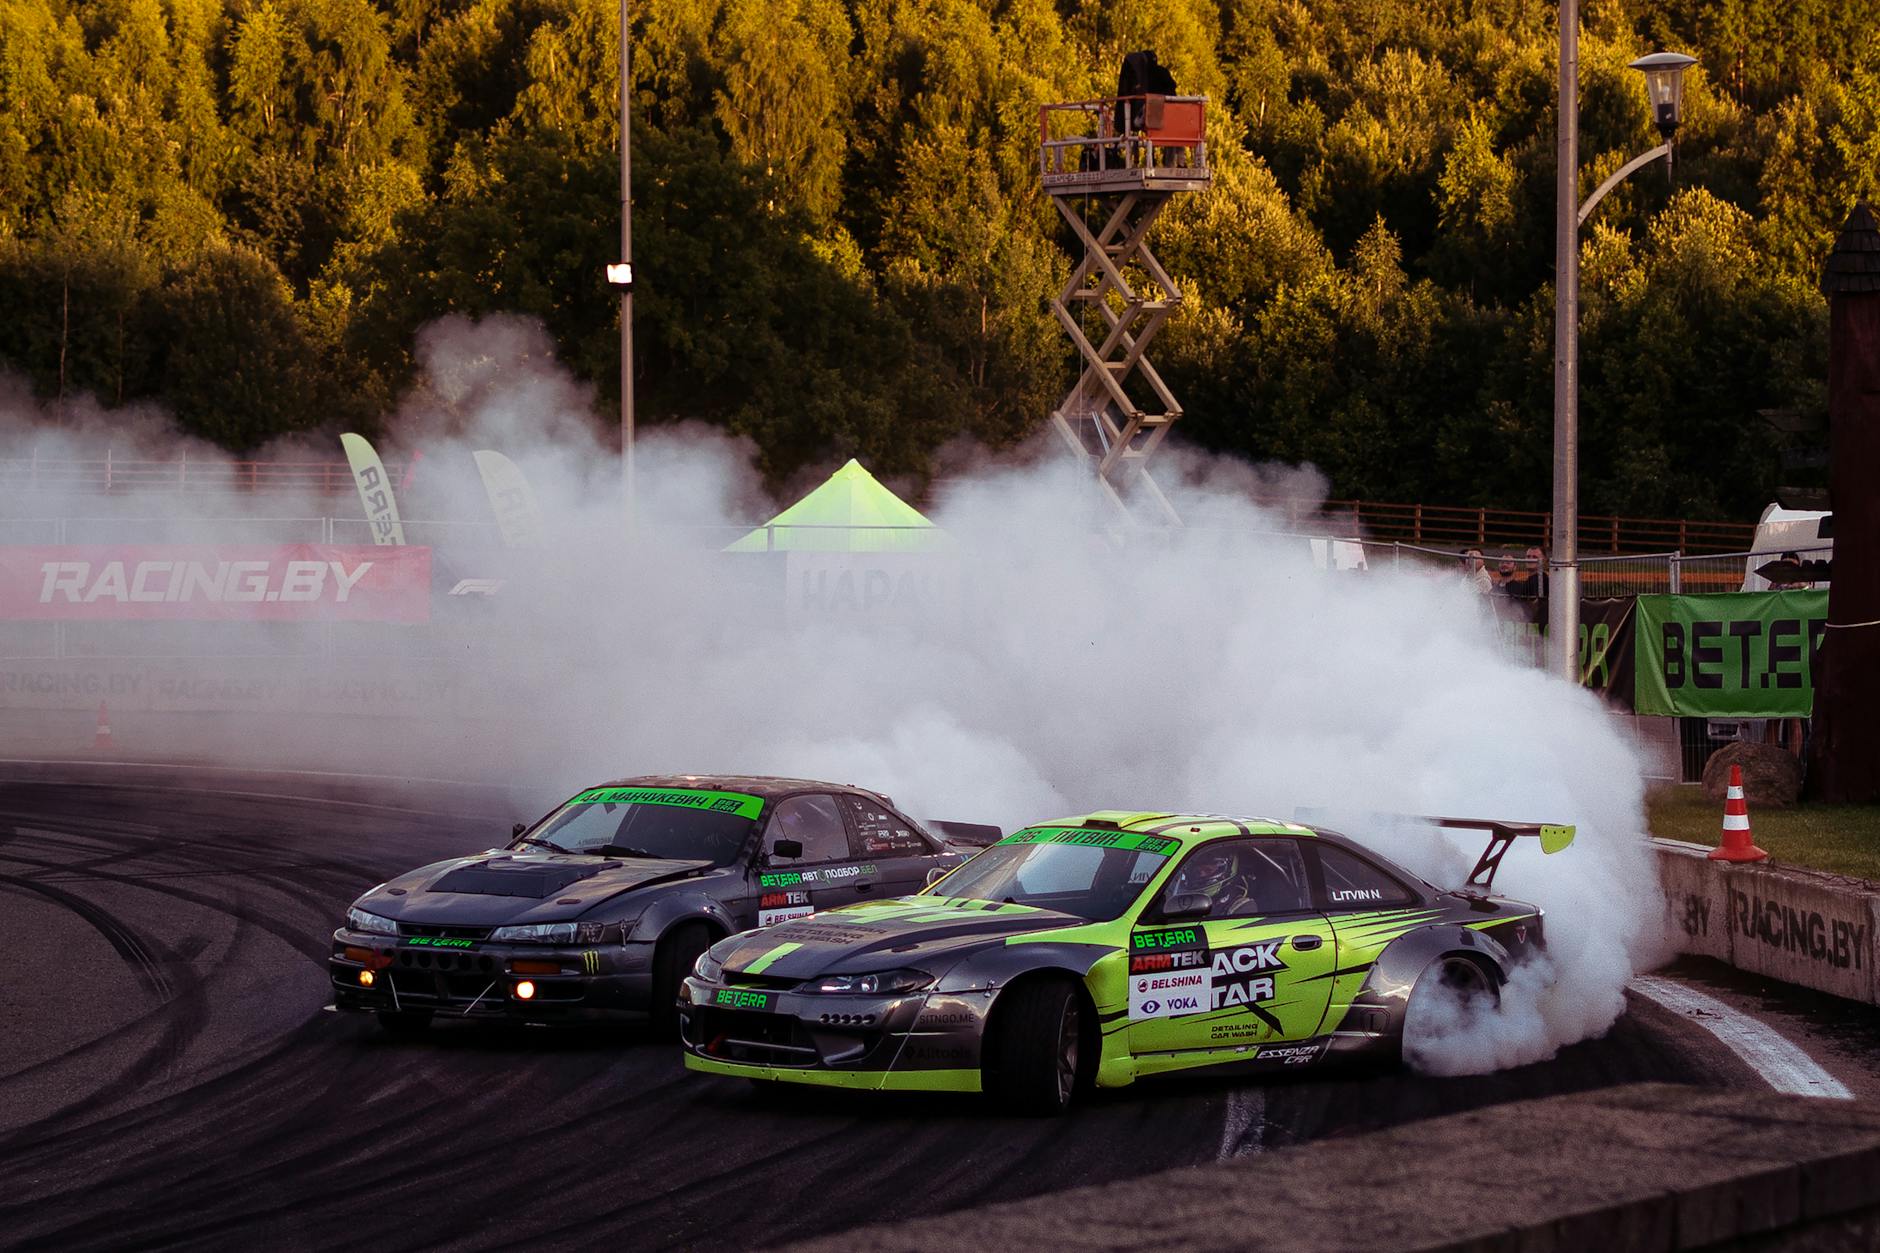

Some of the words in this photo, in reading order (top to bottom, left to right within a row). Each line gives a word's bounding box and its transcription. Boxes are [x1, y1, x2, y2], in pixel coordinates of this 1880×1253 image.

[607, 792, 709, 806] МАНЧУКЕВИЧ
[1050, 830, 1125, 846] ЛИТВИН
[761, 872, 802, 887] BETERA
[761, 891, 809, 907] ARMTEK
[1332, 889, 1369, 901] LITVIN
[1733, 888, 1866, 970] RACING.BY
[409, 936, 473, 948] BETERA
[1134, 930, 1197, 948] BETERA
[1132, 950, 1205, 971] ARMTEK
[1211, 942, 1281, 977] ACK
[1151, 975, 1203, 990] BELSHINA
[716, 989, 767, 1008] BETERA
[1211, 977, 1274, 1009] TAR
[1167, 997, 1198, 1010] VOKA
[1211, 1023, 1258, 1032] DETAILING
[1232, 1030, 1258, 1038] WASH
[1257, 1046, 1320, 1060] ESSENZA
[1284, 1055, 1313, 1065] CAR
